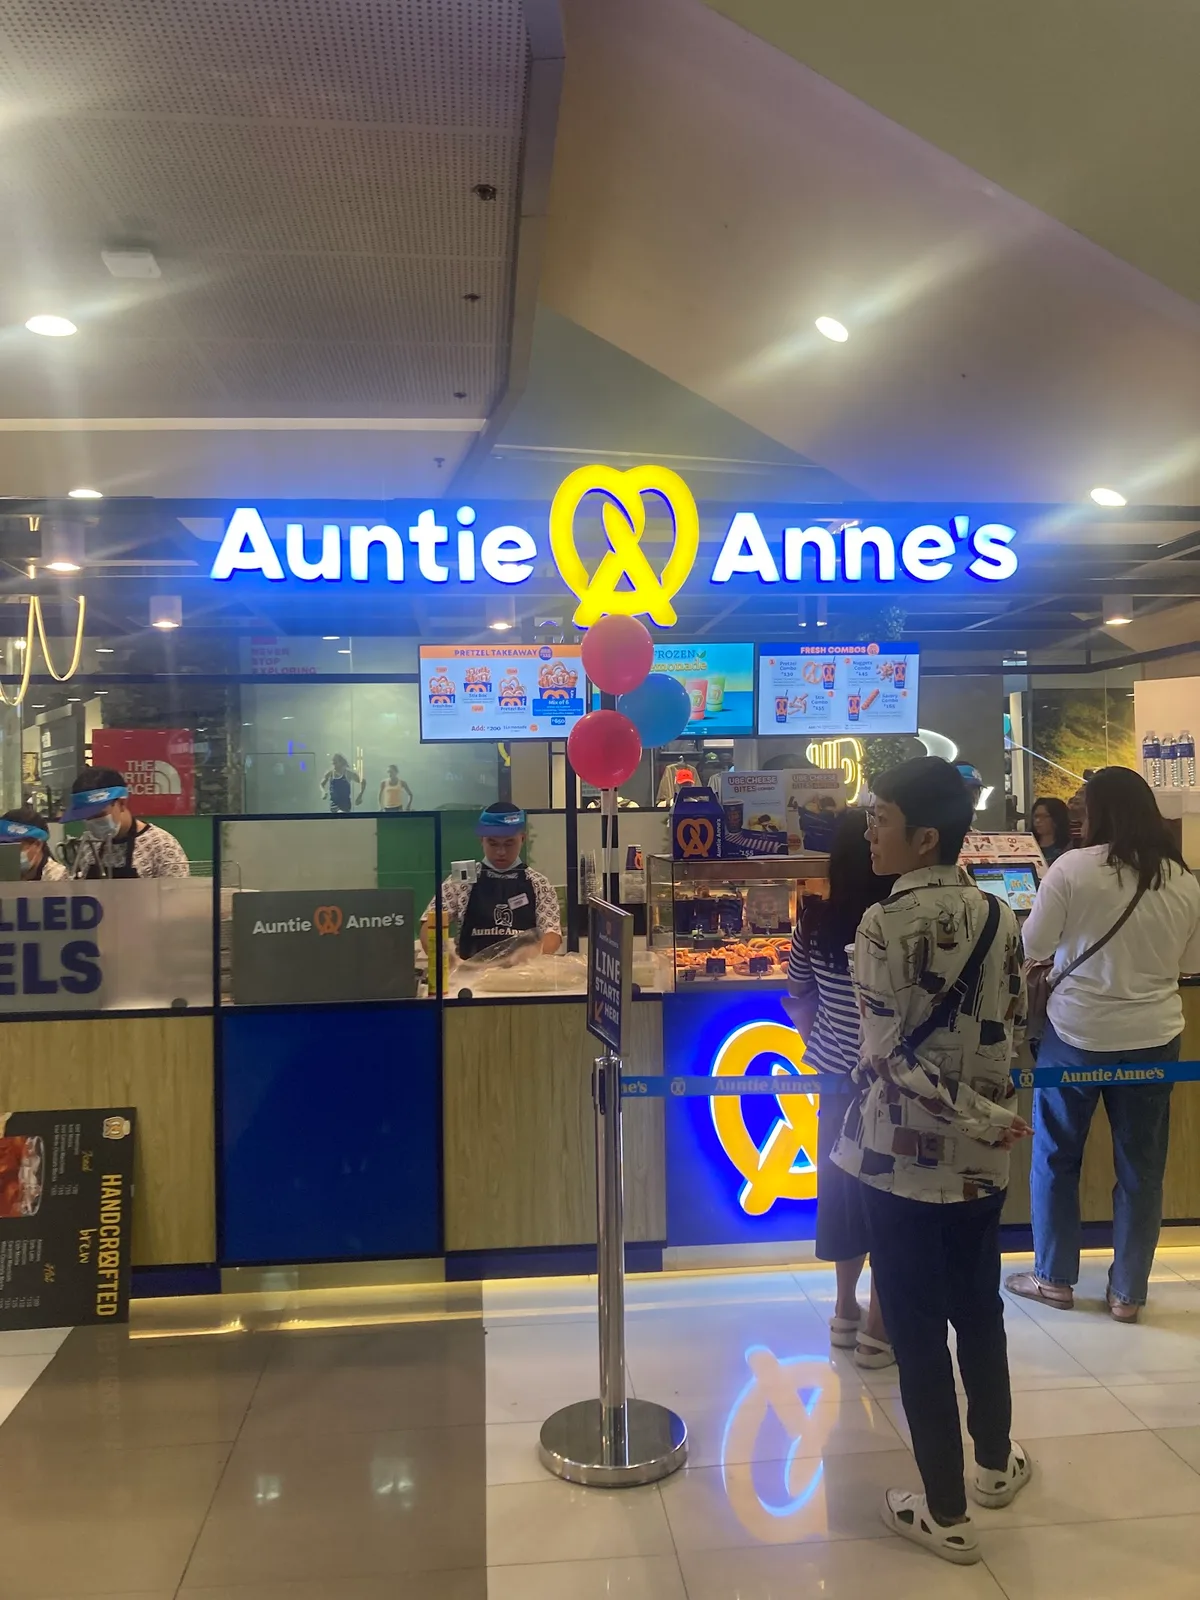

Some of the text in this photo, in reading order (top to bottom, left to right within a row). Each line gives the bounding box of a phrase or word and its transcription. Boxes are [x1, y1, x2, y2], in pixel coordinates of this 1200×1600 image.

[210, 506, 1019, 583] Auntie Anne's
[800, 646, 866, 654] FRESH COMBOS
[125, 760, 154, 771] THE
[122, 772, 154, 783] RTH
[729, 776, 777, 785] UBE CHEESE
[734, 785, 757, 793] BITES
[252, 913, 405, 935] Auntie Anne's
[596, 948, 620, 985] LINE
[595, 976, 620, 1006] STARTS
[1060, 1067, 1165, 1083] Auntie Anne's
[715, 1079, 769, 1092] Auntie
[770, 1078, 821, 1092] Anne's
[78, 1228, 97, 1264] brew
